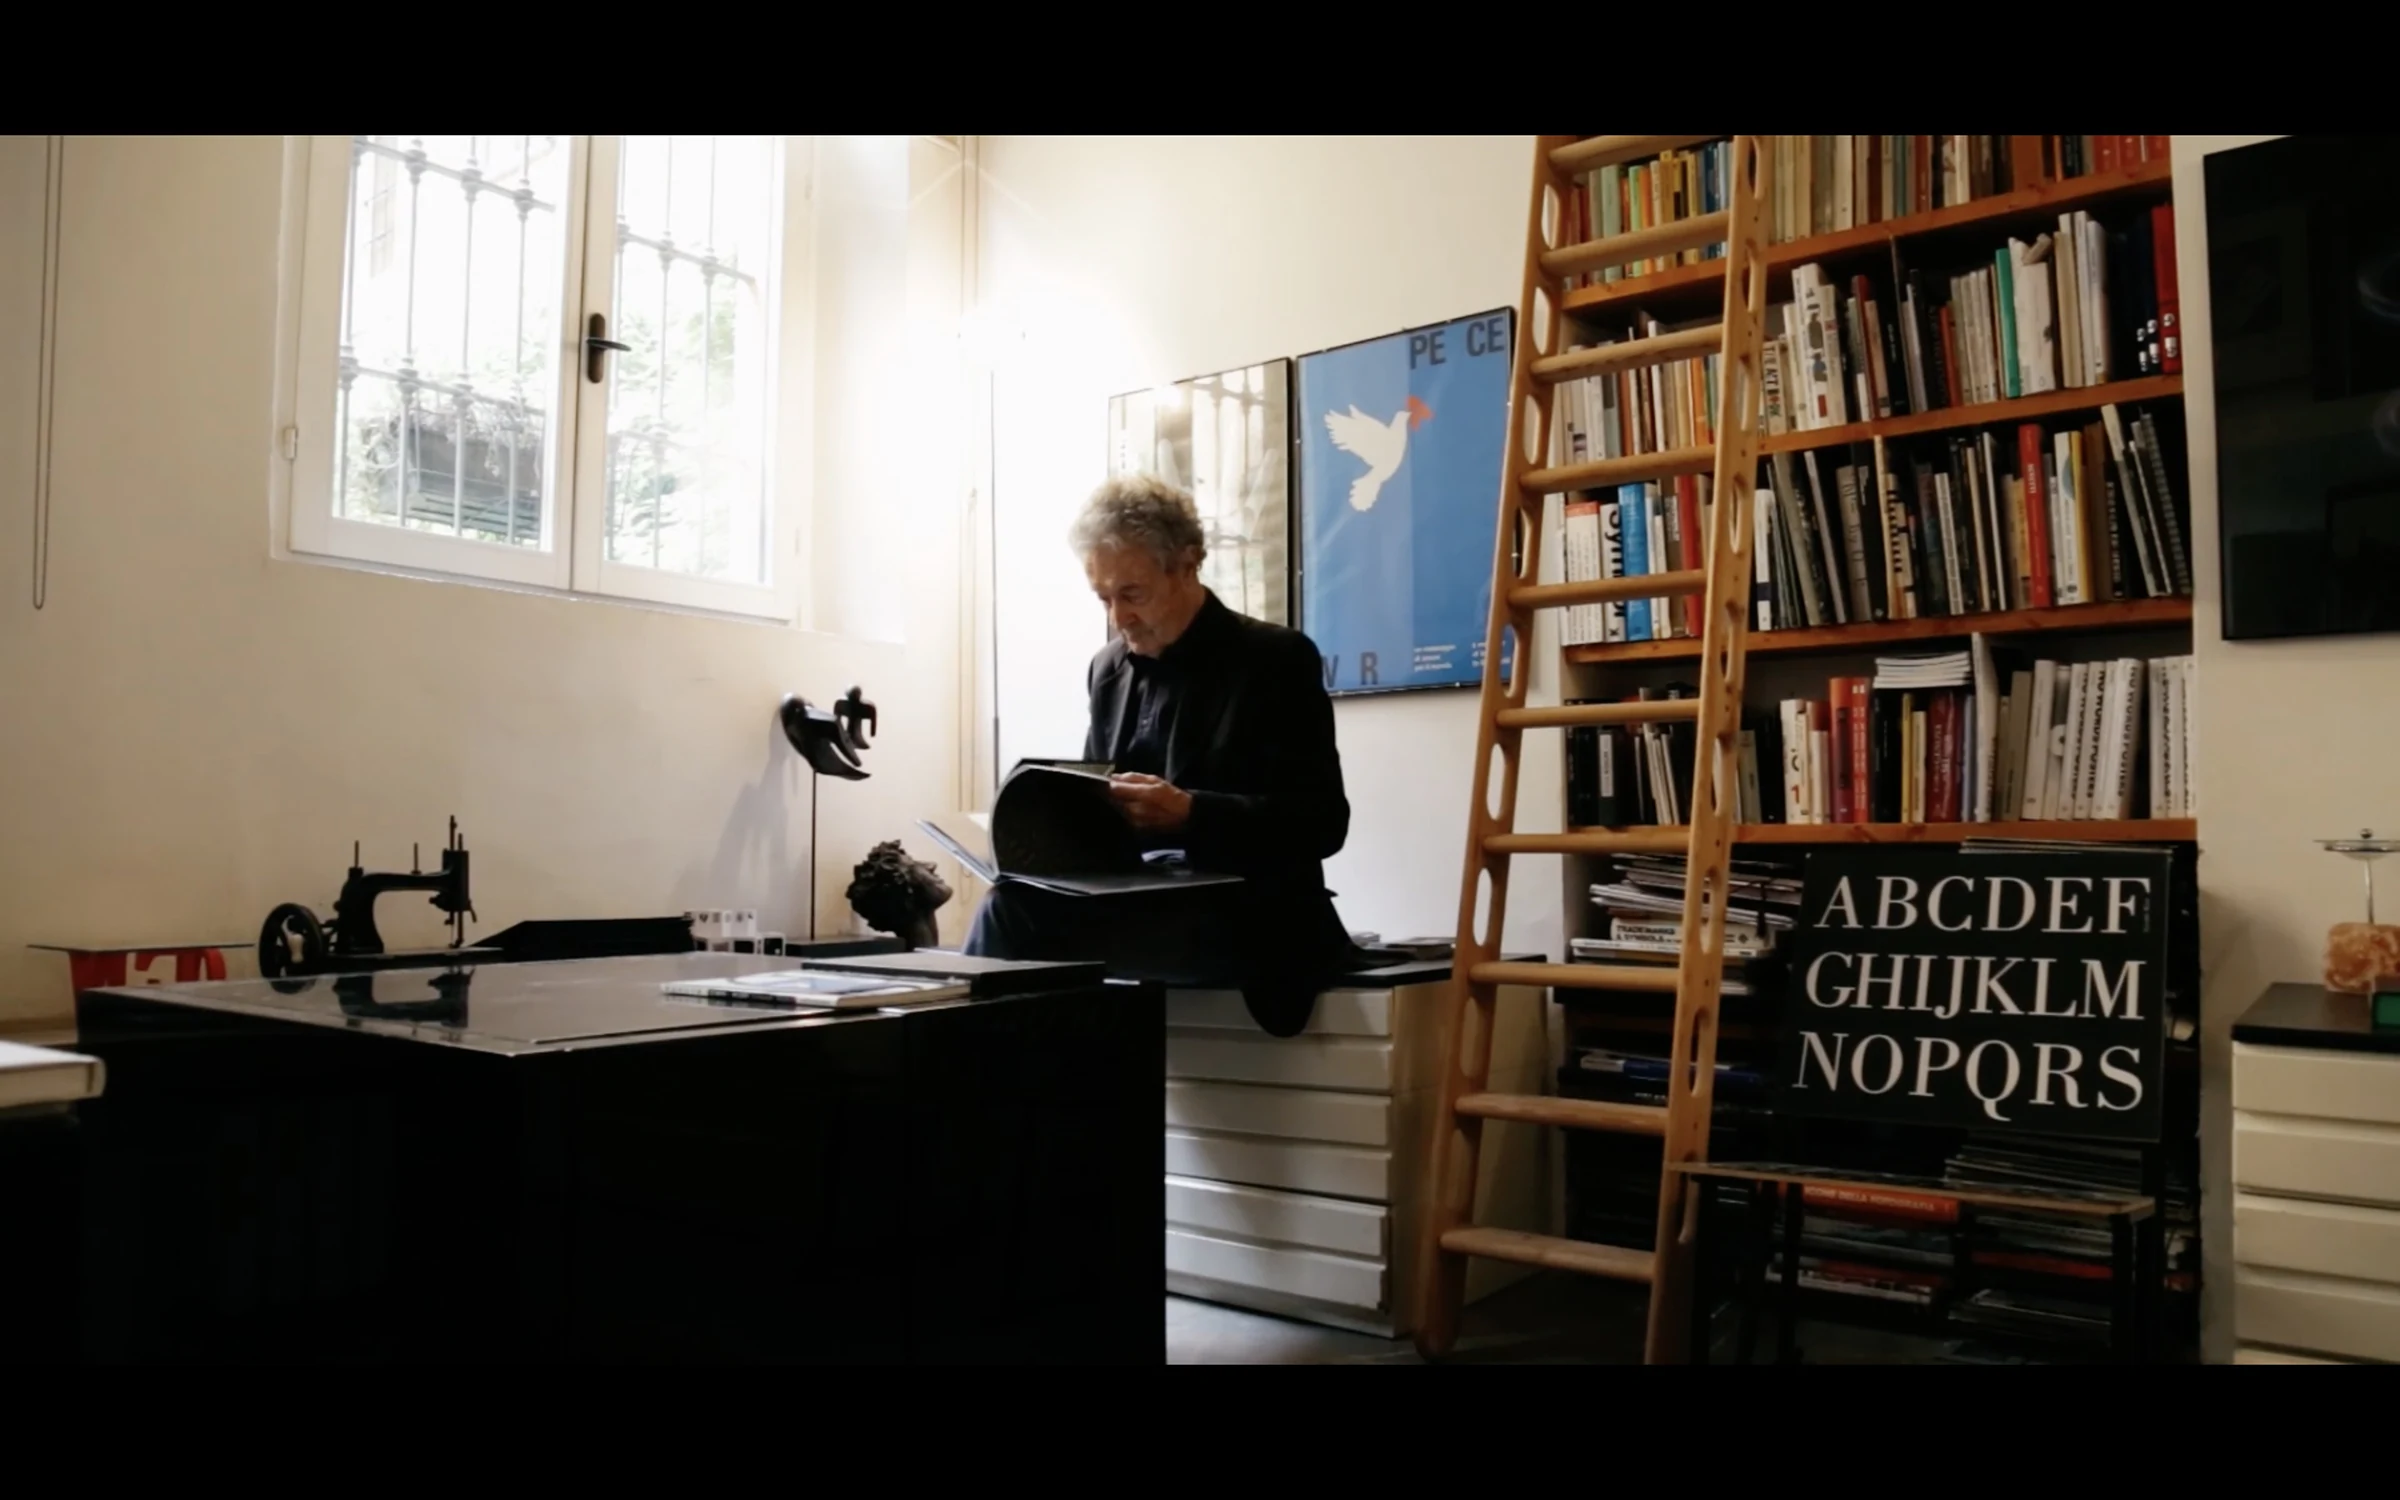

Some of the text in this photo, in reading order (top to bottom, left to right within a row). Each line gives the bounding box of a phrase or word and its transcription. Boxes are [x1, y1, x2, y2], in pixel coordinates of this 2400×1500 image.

[1409, 315, 1504, 370] PE CE
[1360, 651, 1379, 685] R
[2091, 694, 2104, 742] WORDS
[2123, 691, 2136, 740] WORDS
[2086, 745, 2099, 799] POSTERS
[2117, 742, 2130, 797] POSTERS
[1813, 874, 2152, 936] ABCDEF
[1805, 951, 2147, 1021] GHIJKLM
[1791, 1029, 2144, 1122] NOPQRS
